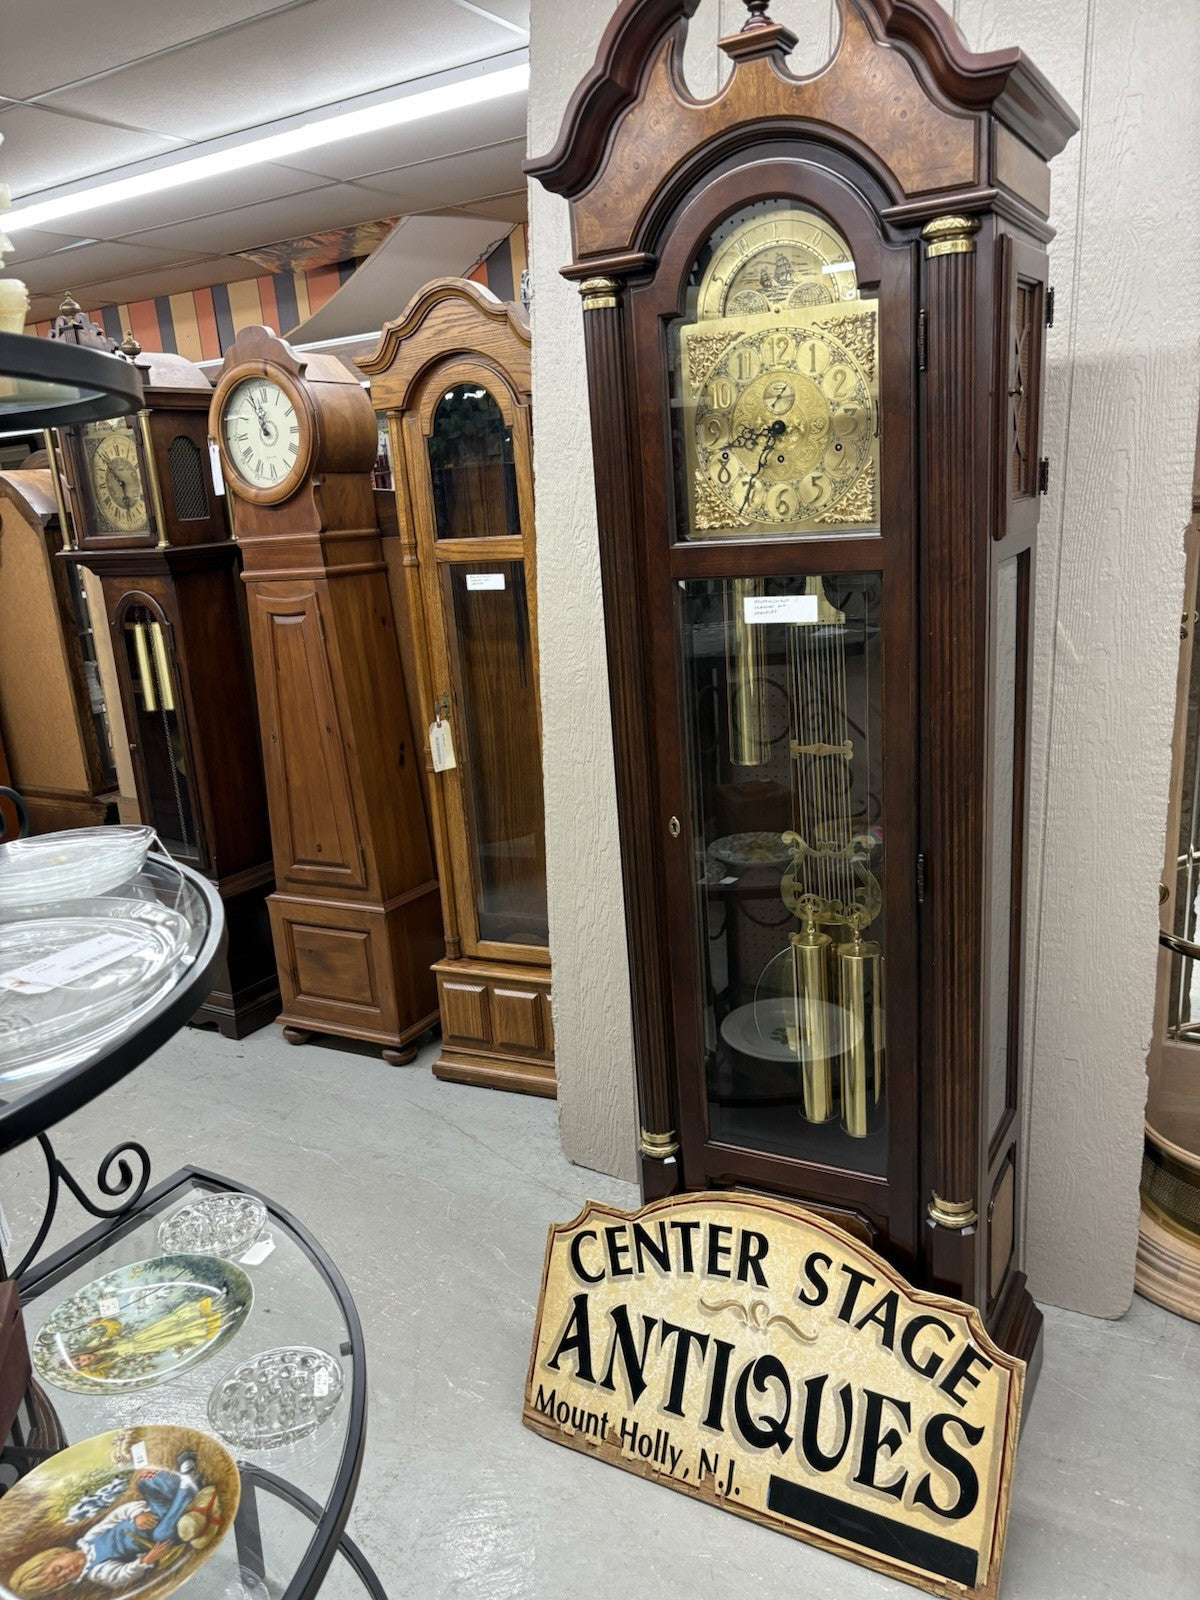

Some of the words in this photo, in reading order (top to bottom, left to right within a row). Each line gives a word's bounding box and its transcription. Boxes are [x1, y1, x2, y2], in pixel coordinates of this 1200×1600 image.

[769, 337, 789, 366] 12
[808, 343, 816, 372] 1
[737, 352, 751, 381] 11
[712, 382, 732, 409] 10
[832, 370, 847, 397] 2
[708, 419, 721, 446] 9
[842, 408, 858, 435] 3
[718, 457, 731, 484] 8
[775, 488, 789, 516] 6
[810, 475, 824, 504] 5
[570, 1221, 770, 1288] CENTER
[798, 1252, 993, 1406] STAGE
[547, 1293, 986, 1520] ANTIQUES
[534, 1384, 608, 1440] Mount
[620, 1417, 689, 1479] Holly,
